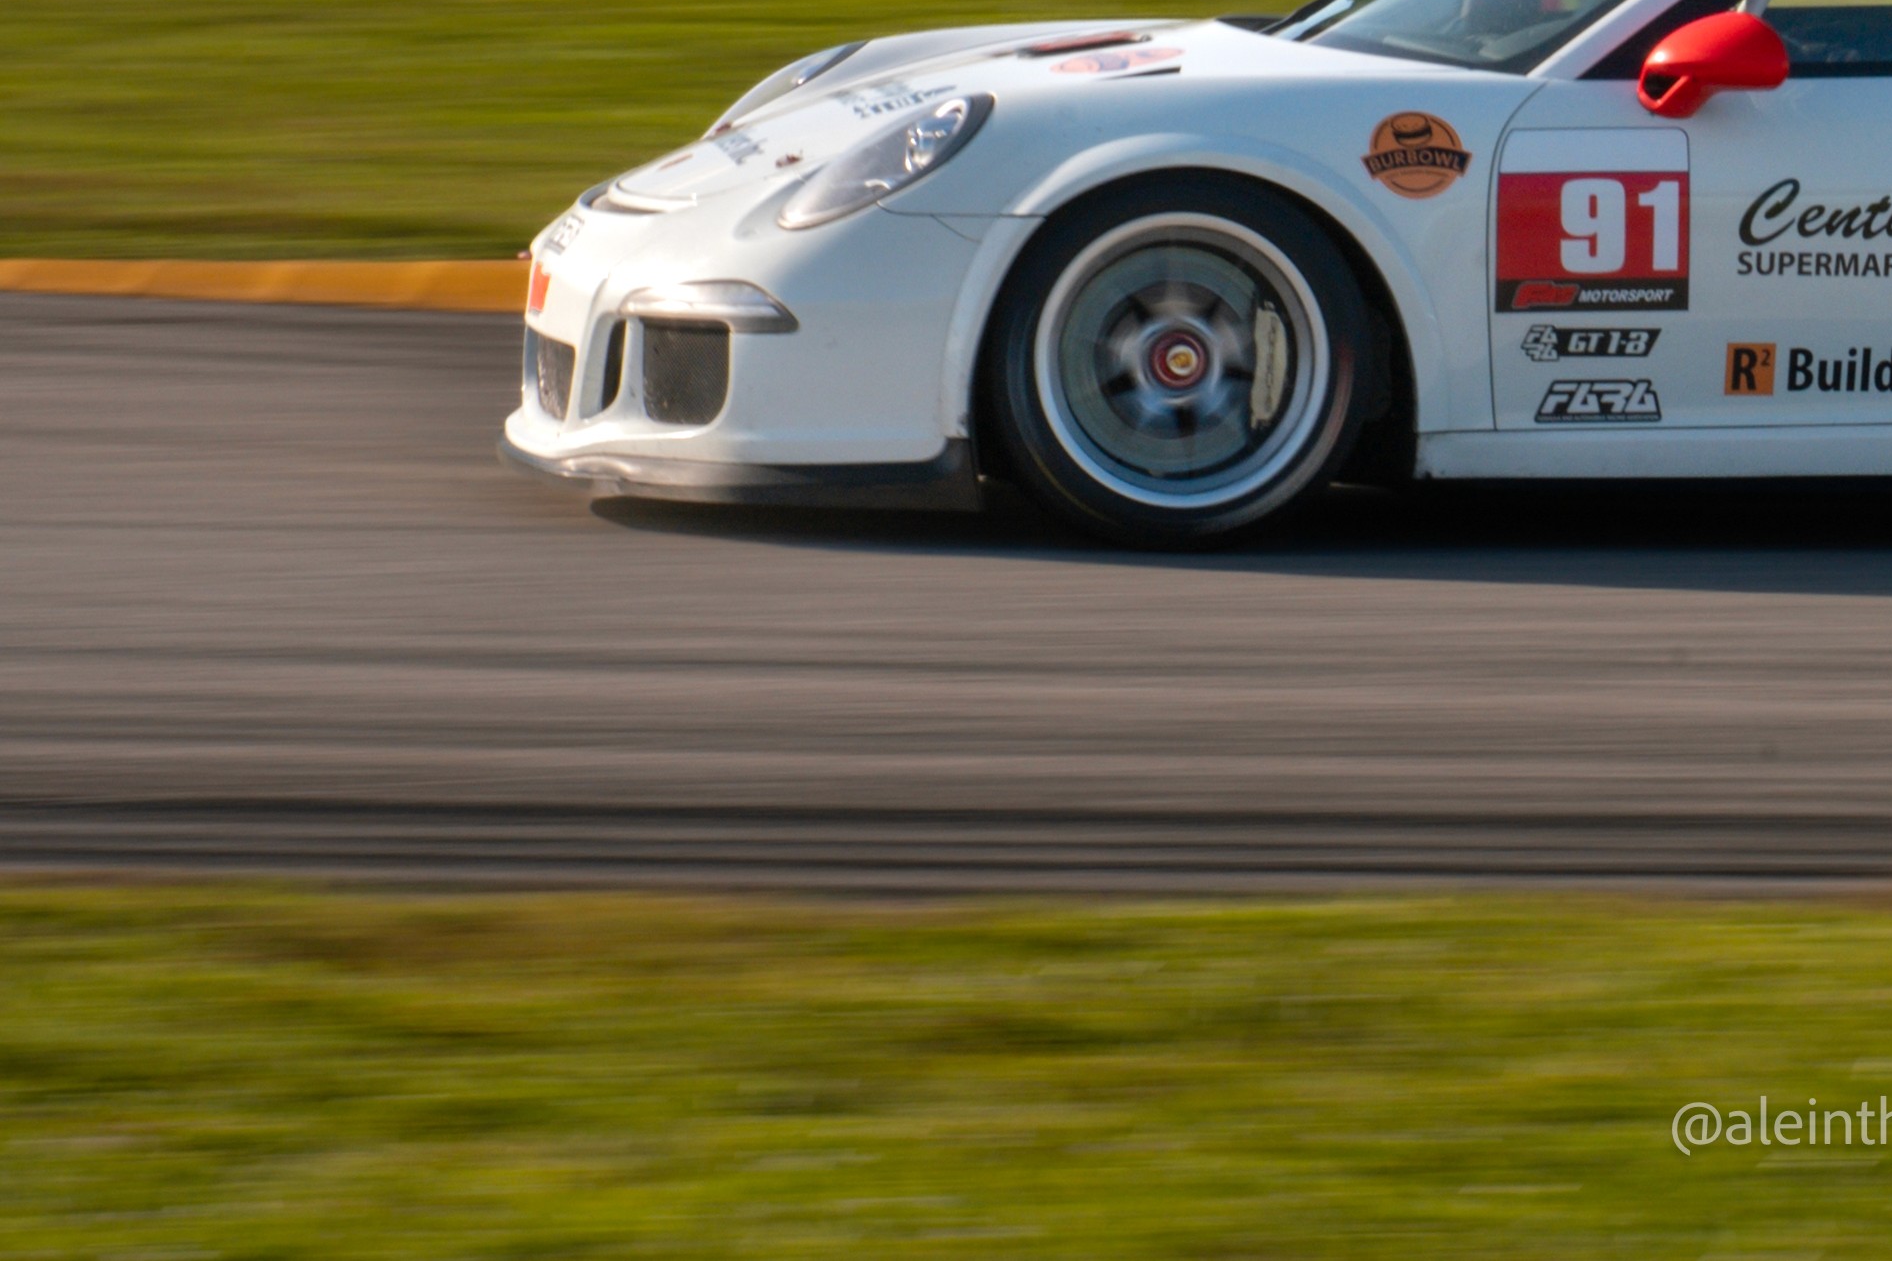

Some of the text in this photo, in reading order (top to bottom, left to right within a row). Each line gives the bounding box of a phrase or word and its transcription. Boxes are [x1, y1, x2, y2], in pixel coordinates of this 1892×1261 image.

[1368, 149, 1461, 173] BURBOWL
[1560, 177, 1680, 274] 91
[1578, 288, 1674, 304] MOTORSPORT
